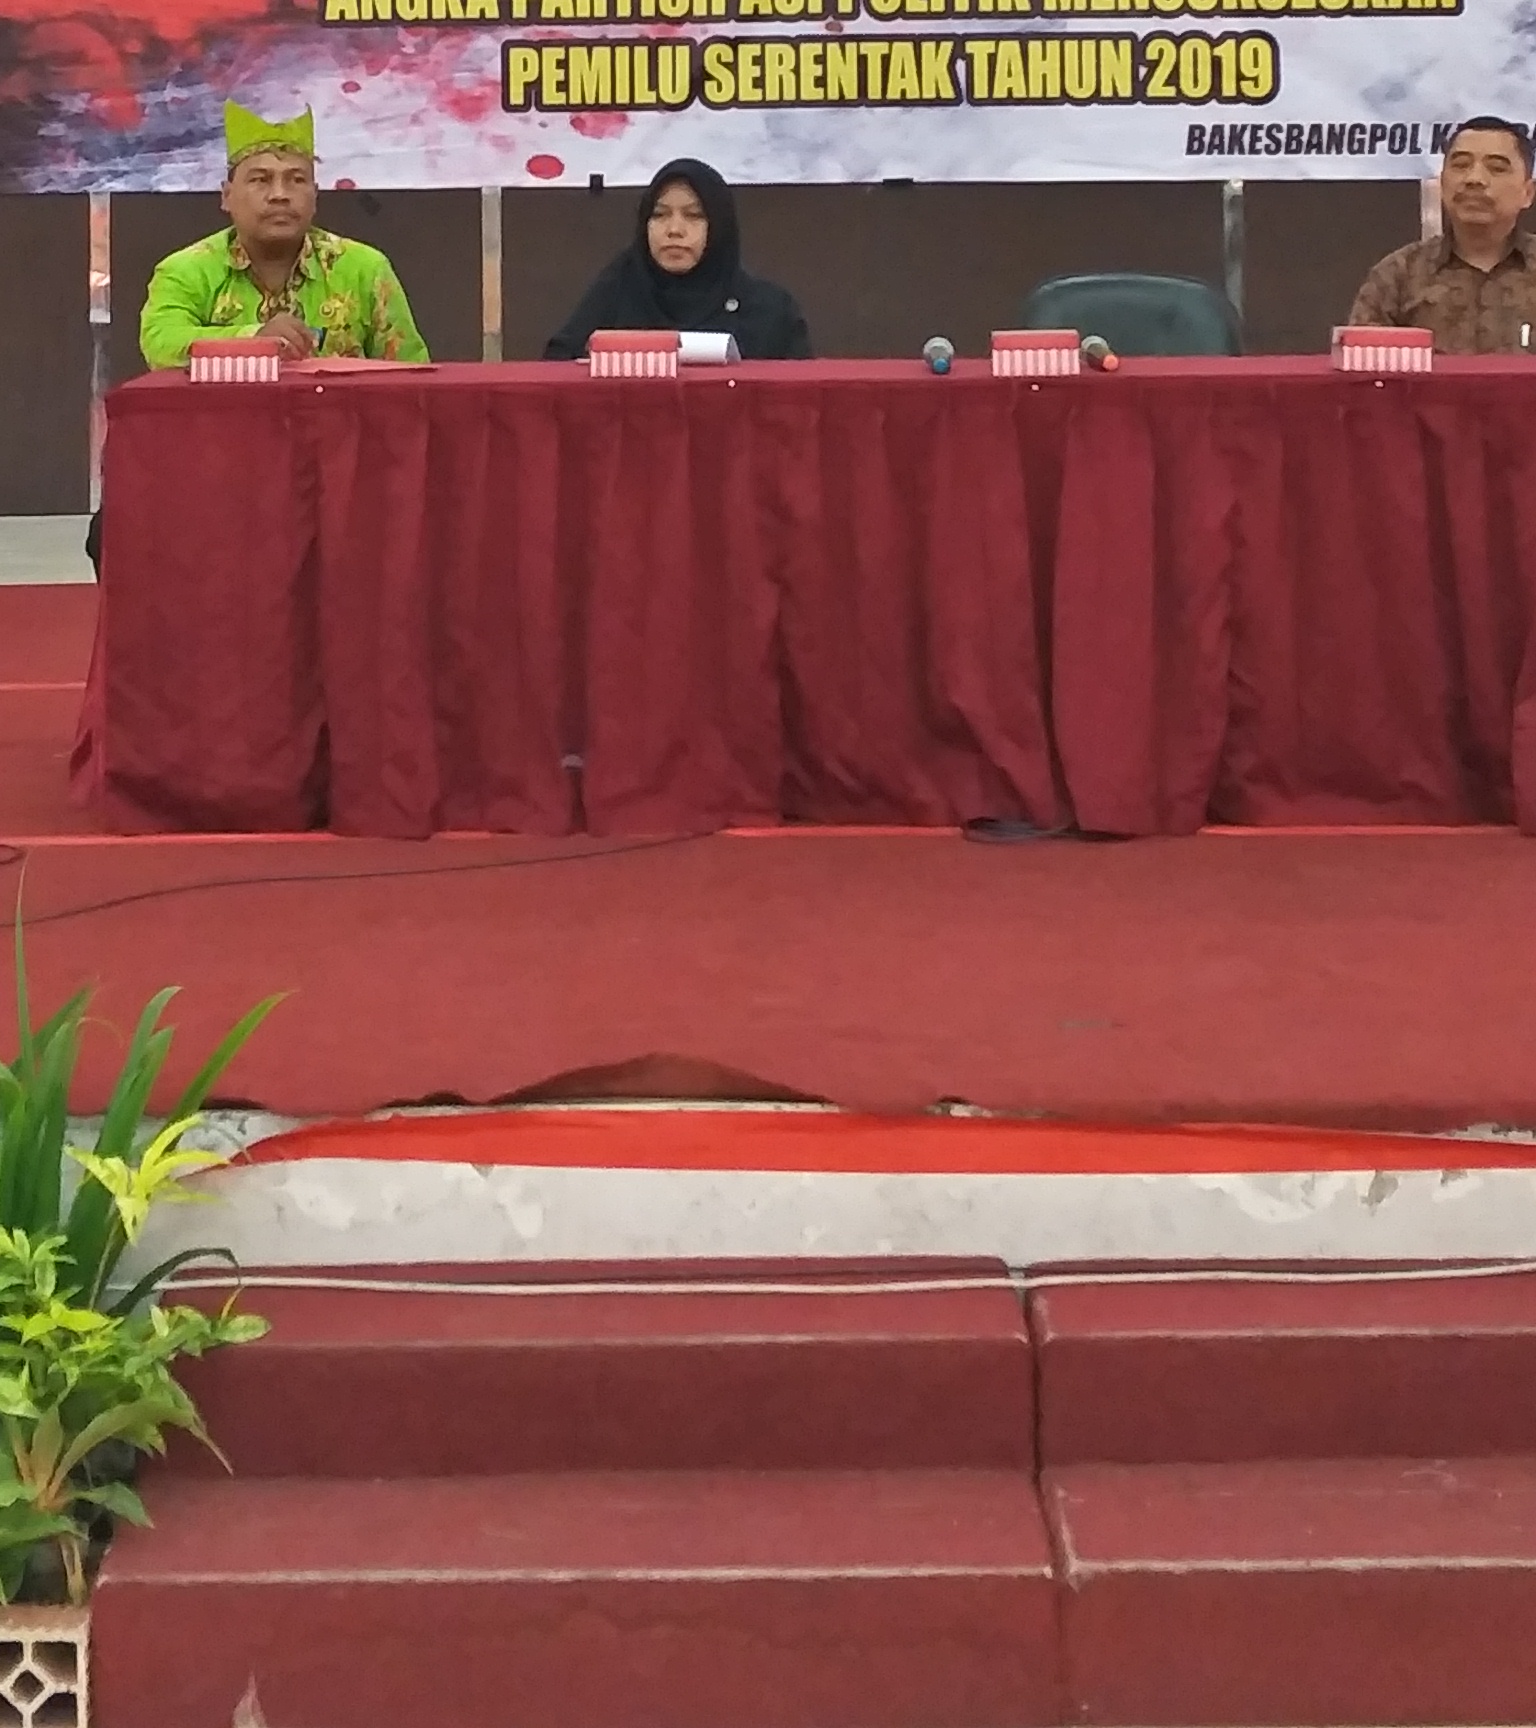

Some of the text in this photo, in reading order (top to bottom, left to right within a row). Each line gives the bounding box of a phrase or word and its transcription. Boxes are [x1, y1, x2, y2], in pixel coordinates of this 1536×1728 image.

[508, 37, 1273, 105] PEMILU SERENTAK TAHUN 2019
[1184, 122, 1423, 156] BAKESBANGPOL
